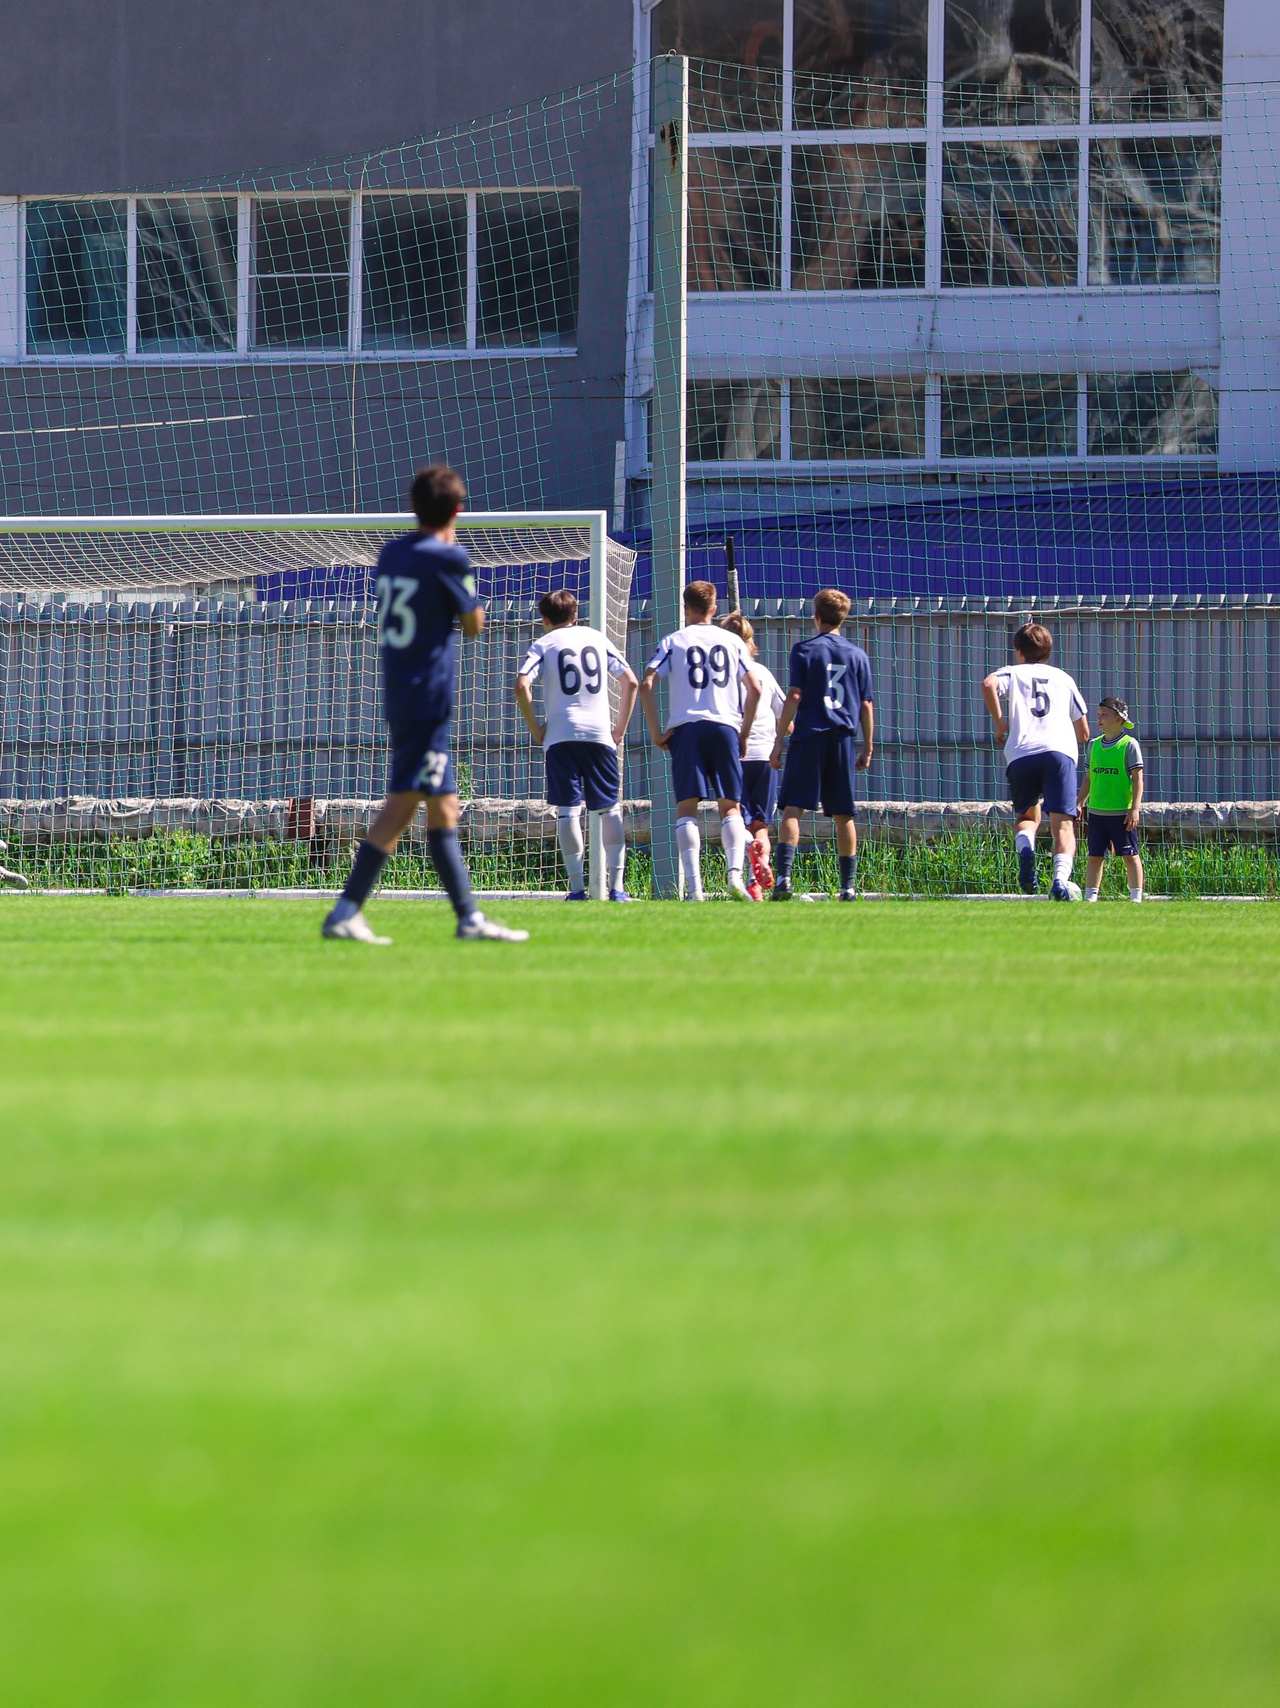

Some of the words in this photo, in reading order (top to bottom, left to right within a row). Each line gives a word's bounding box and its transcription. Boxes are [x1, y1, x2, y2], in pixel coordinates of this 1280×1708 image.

[558, 645, 601, 696] 69
[686, 644, 730, 690] 89
[823, 663, 847, 710] 3
[1030, 677, 1051, 718] 5
[418, 750, 449, 788] 23
